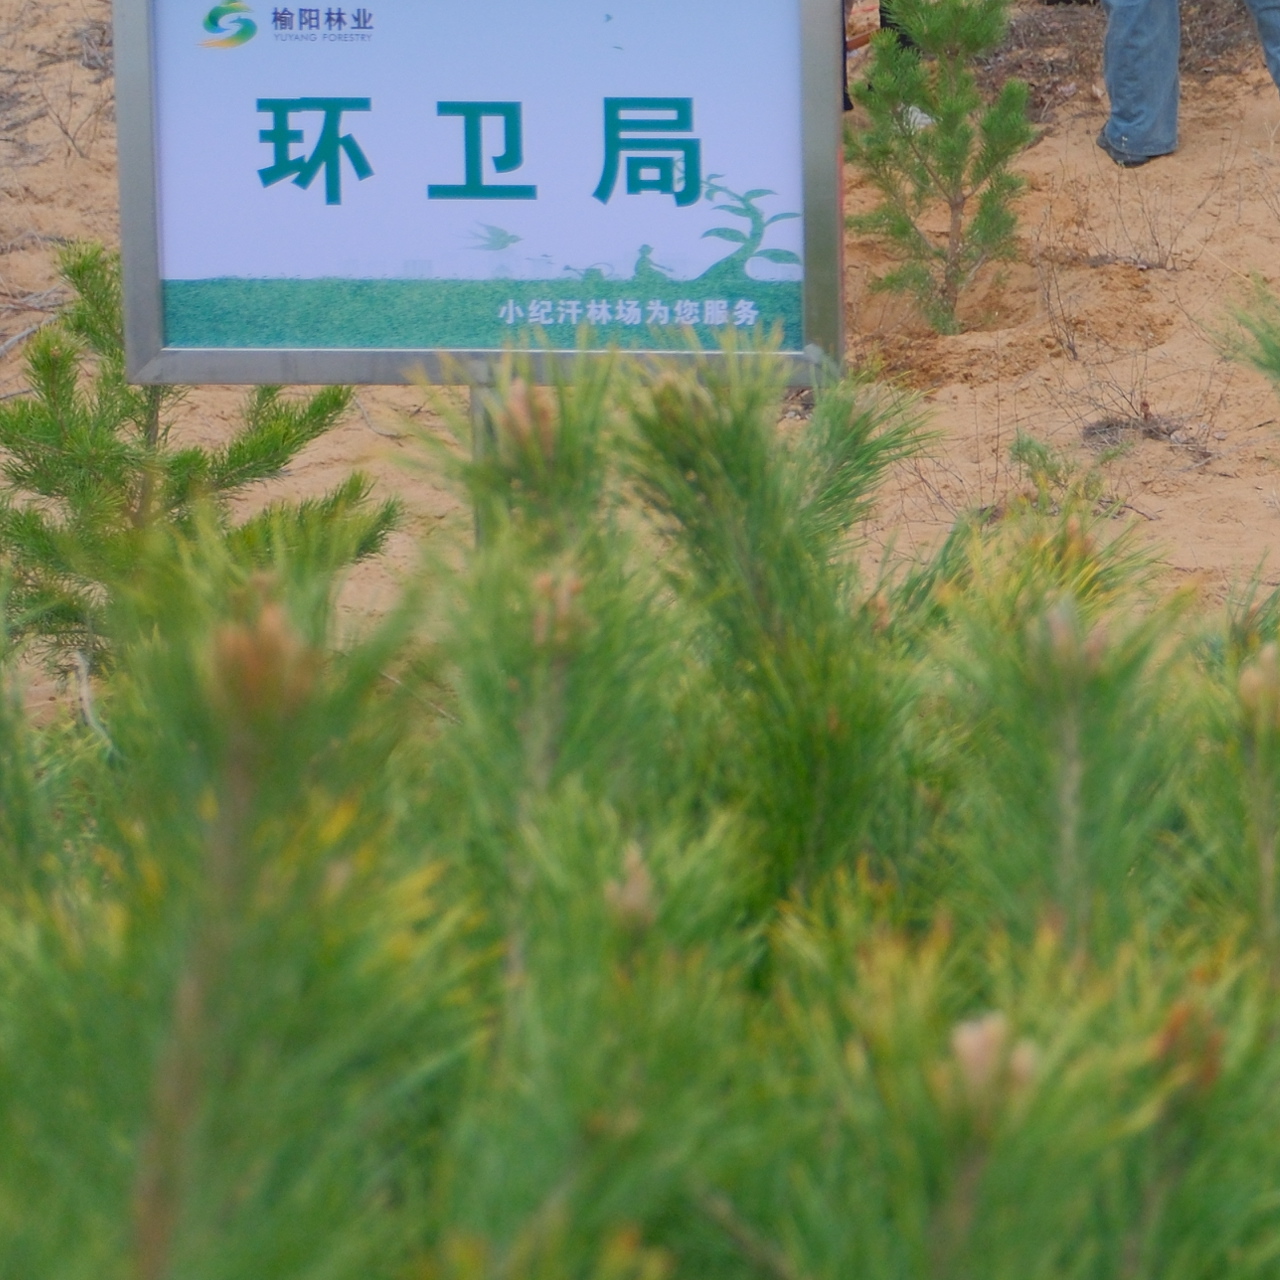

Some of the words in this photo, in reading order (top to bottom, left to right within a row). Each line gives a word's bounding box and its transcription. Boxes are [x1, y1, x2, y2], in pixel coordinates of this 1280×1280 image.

[271, 7, 375, 31] 榆阳林业
[274, 33, 318, 42] YUYANG
[322, 33, 373, 42] FORESTRY
[256, 96, 704, 207] 环卫局
[498, 298, 760, 326] 小纪汗林场为您服务
